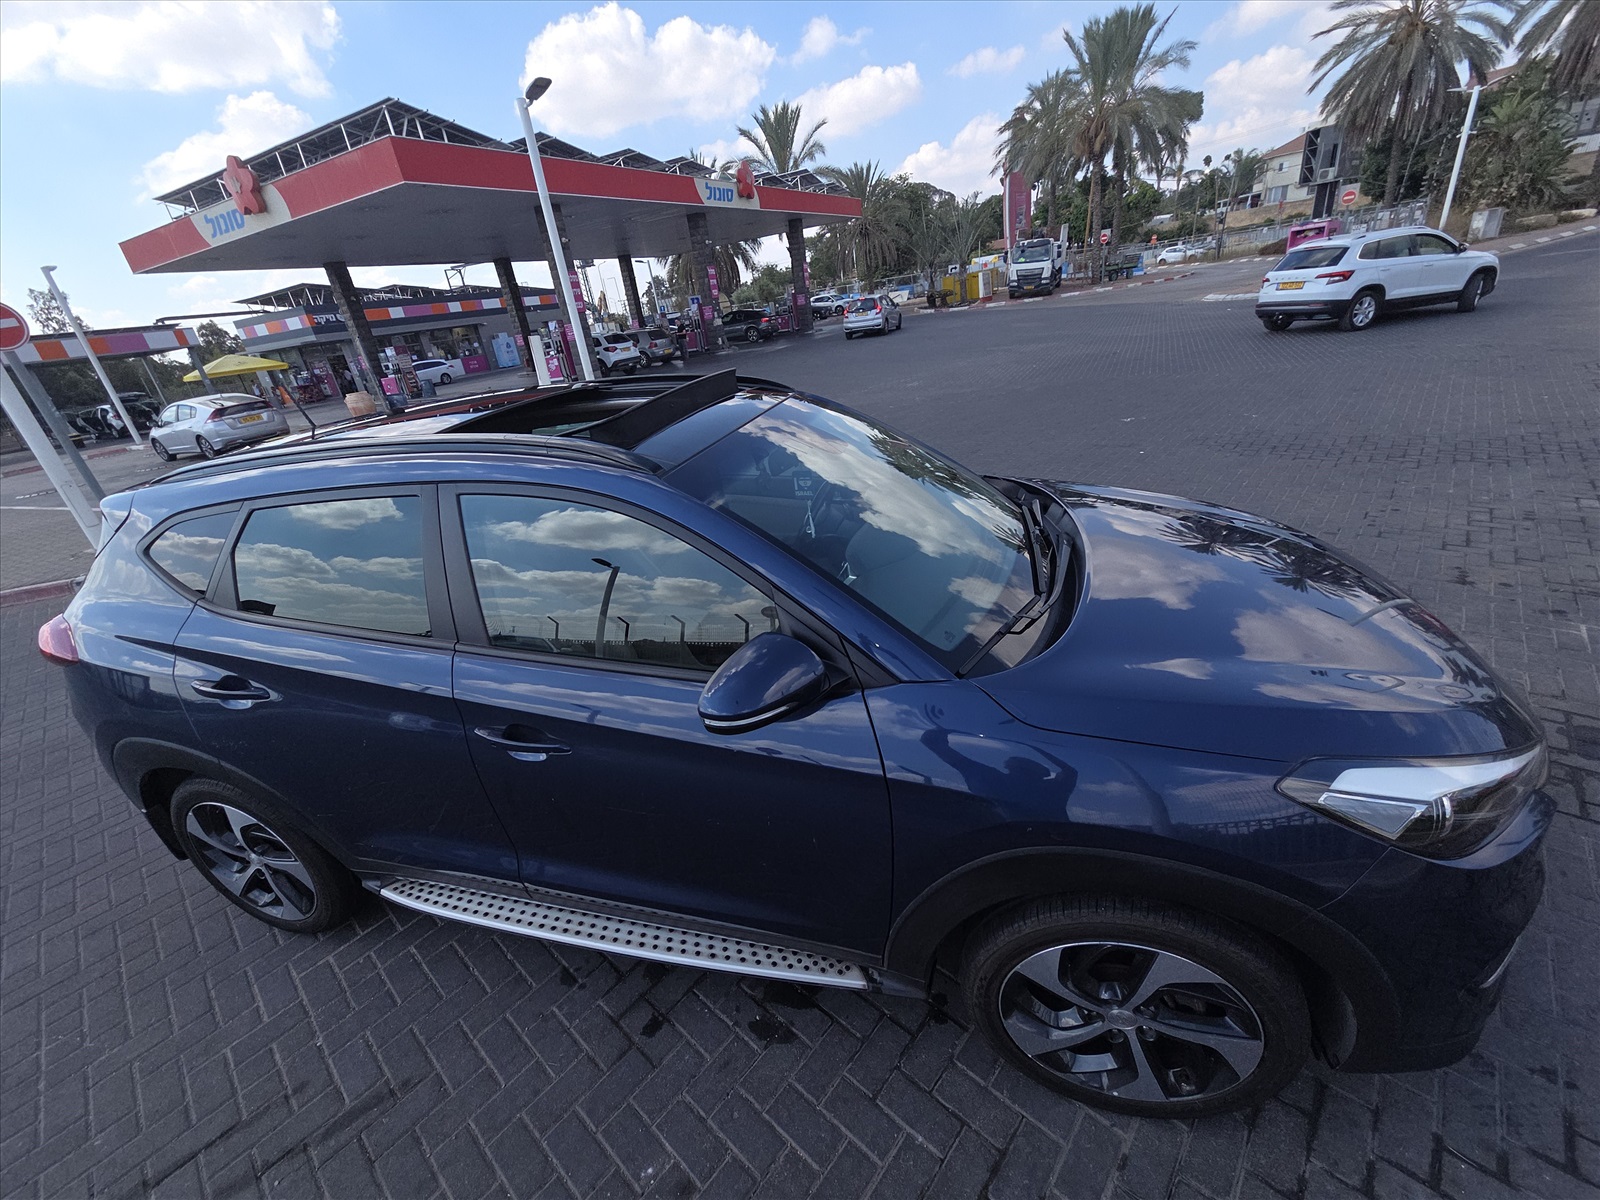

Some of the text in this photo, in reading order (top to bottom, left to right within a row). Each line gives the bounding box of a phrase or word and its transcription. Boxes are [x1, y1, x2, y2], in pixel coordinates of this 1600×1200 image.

[705, 181, 734, 202] סונול
[203, 208, 245, 239] סונול
[312, 314, 336, 325] מיקה
